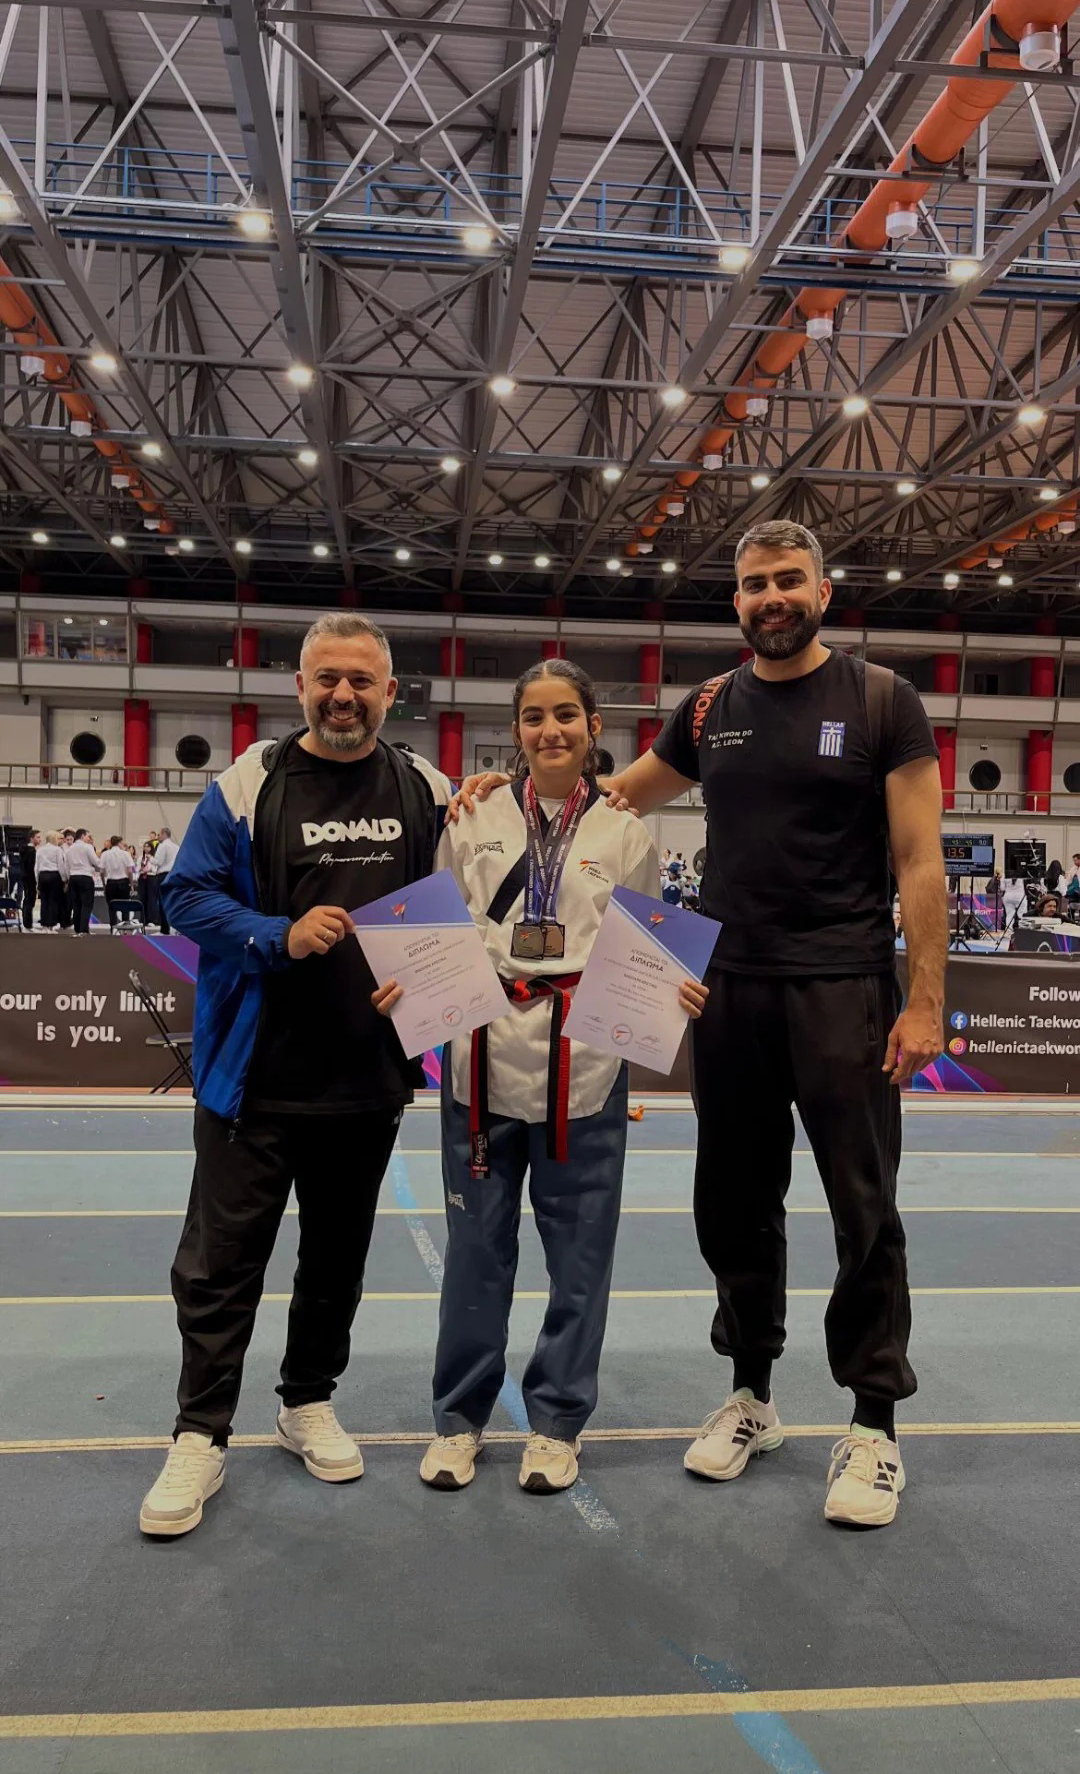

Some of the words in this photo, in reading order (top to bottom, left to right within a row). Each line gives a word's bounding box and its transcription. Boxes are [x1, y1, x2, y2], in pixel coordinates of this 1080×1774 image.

[723, 739, 743, 747] LEON
[301, 818, 403, 846] DONALD
[0, 993, 42, 1011] our
[55, 990, 107, 1017] only
[120, 990, 176, 1012] limit
[1029, 986, 1080, 1001] Follow
[970, 1014, 1026, 1028] Hellenic
[1029, 1015, 1080, 1029] Taekwo
[37, 1022, 56, 1041] is
[69, 1025, 121, 1047] you.
